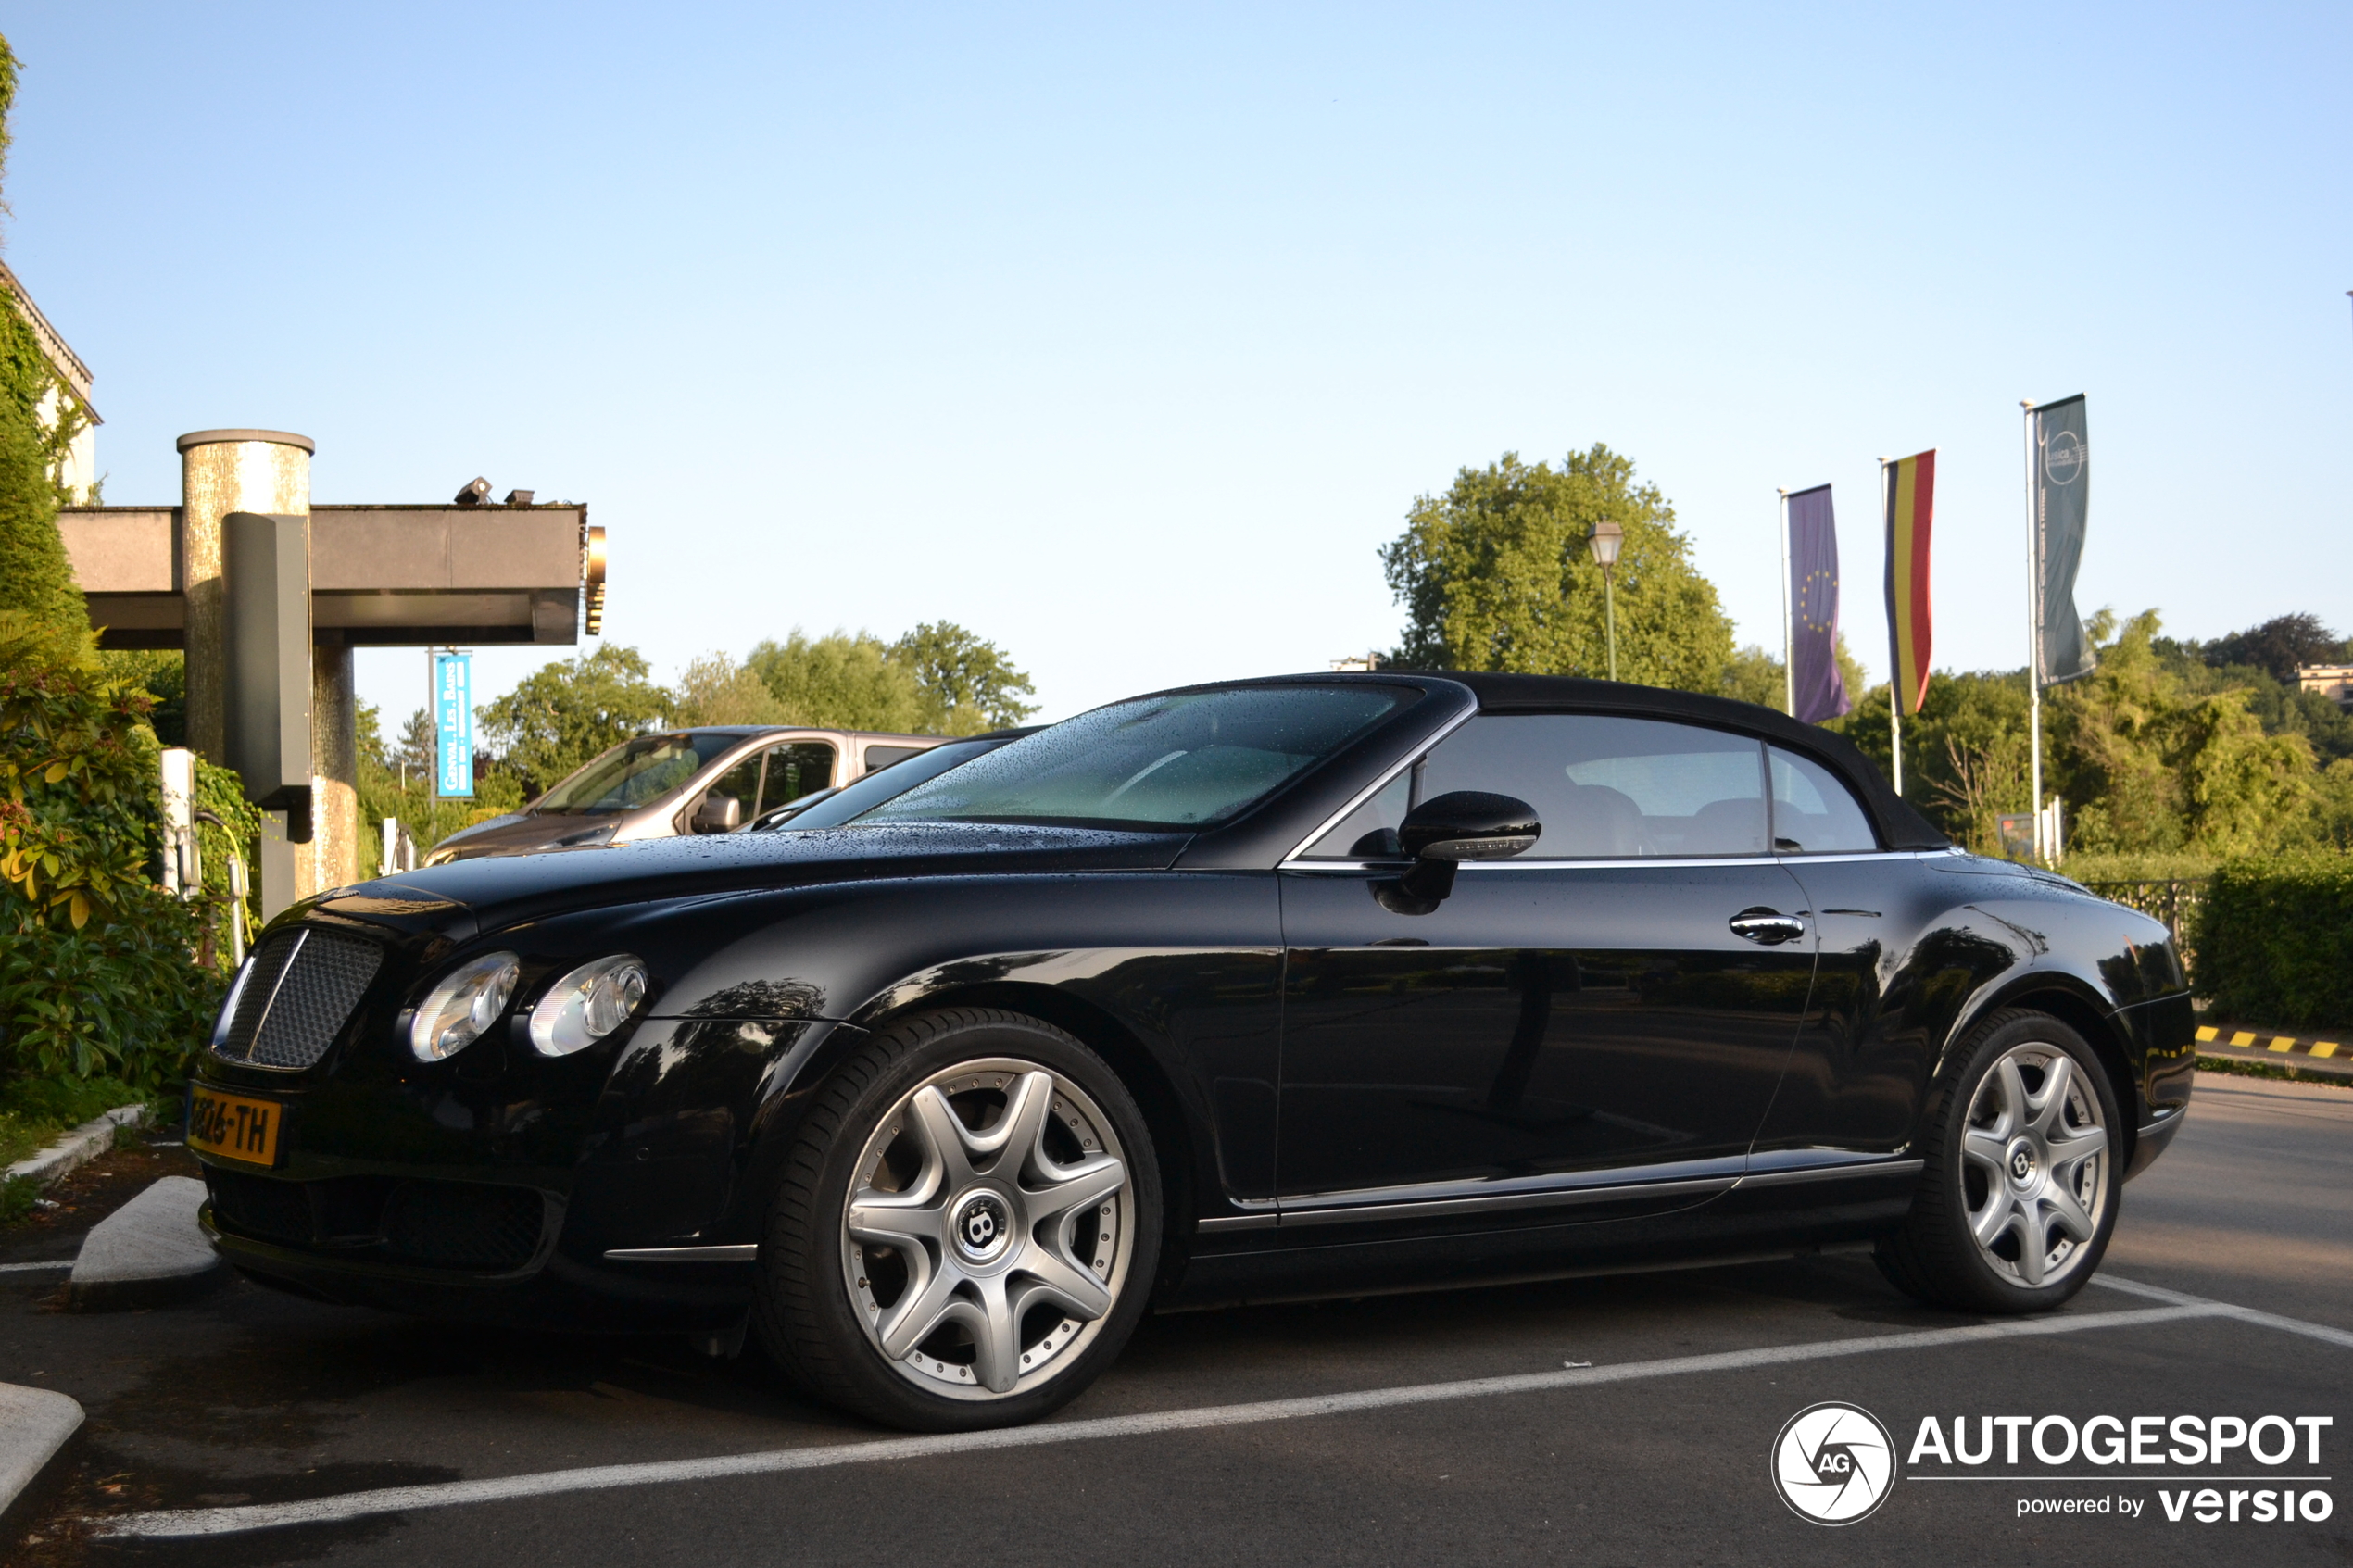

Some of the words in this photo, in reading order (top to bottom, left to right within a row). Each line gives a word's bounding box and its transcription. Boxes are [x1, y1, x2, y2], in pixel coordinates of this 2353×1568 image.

[443, 661, 457, 701] BAINS
[443, 708, 457, 732] LES
[444, 739, 458, 791] GENVAL
